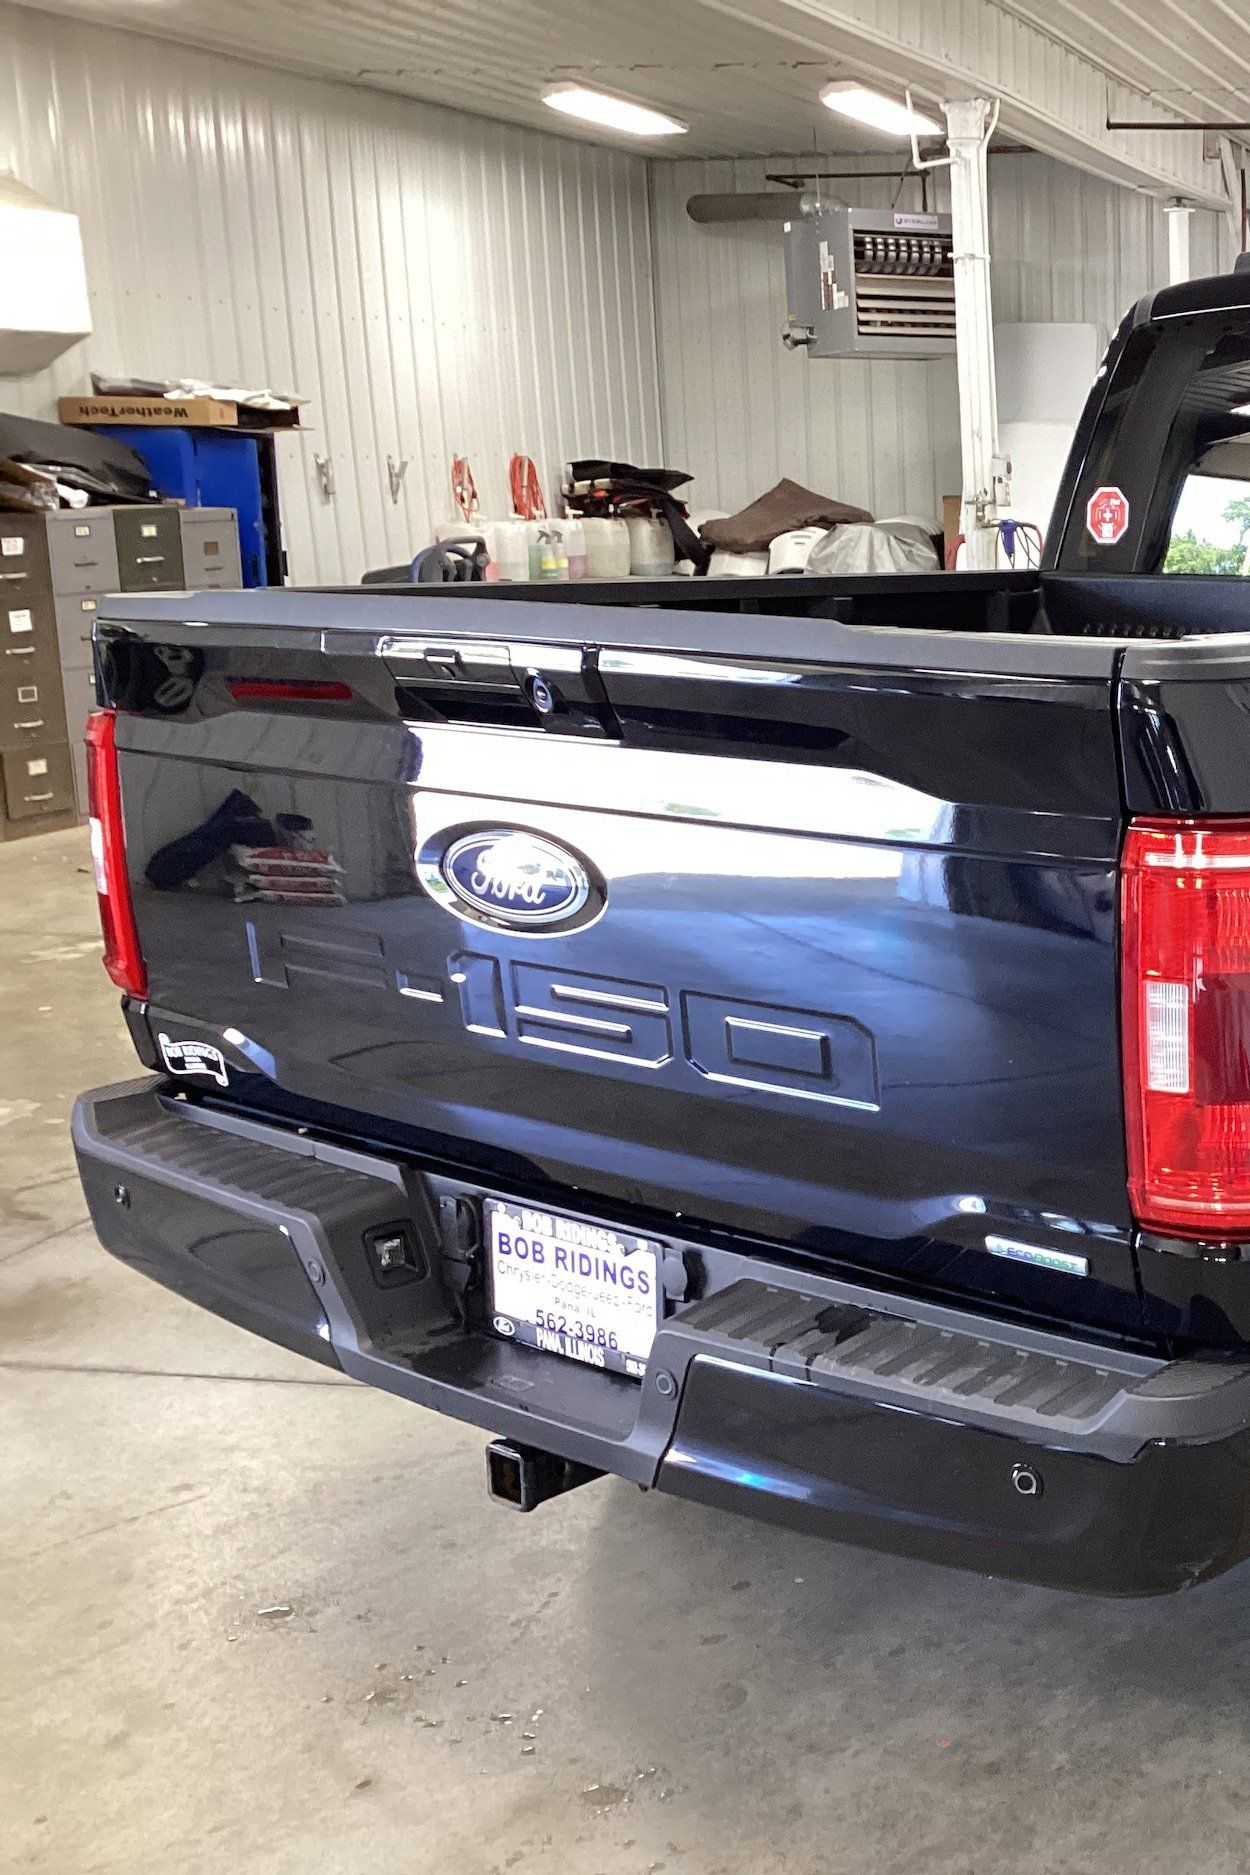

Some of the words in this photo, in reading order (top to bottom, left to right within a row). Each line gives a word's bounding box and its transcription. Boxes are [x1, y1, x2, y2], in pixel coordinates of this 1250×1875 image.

[78, 405, 189, 419] WeatherTech
[470, 847, 547, 905] Ford
[246, 921, 880, 1111] F-150
[497, 1231, 546, 1264] BOB
[554, 1246, 651, 1295] RIDINGS
[535, 1309, 618, 1350] 562-3986
